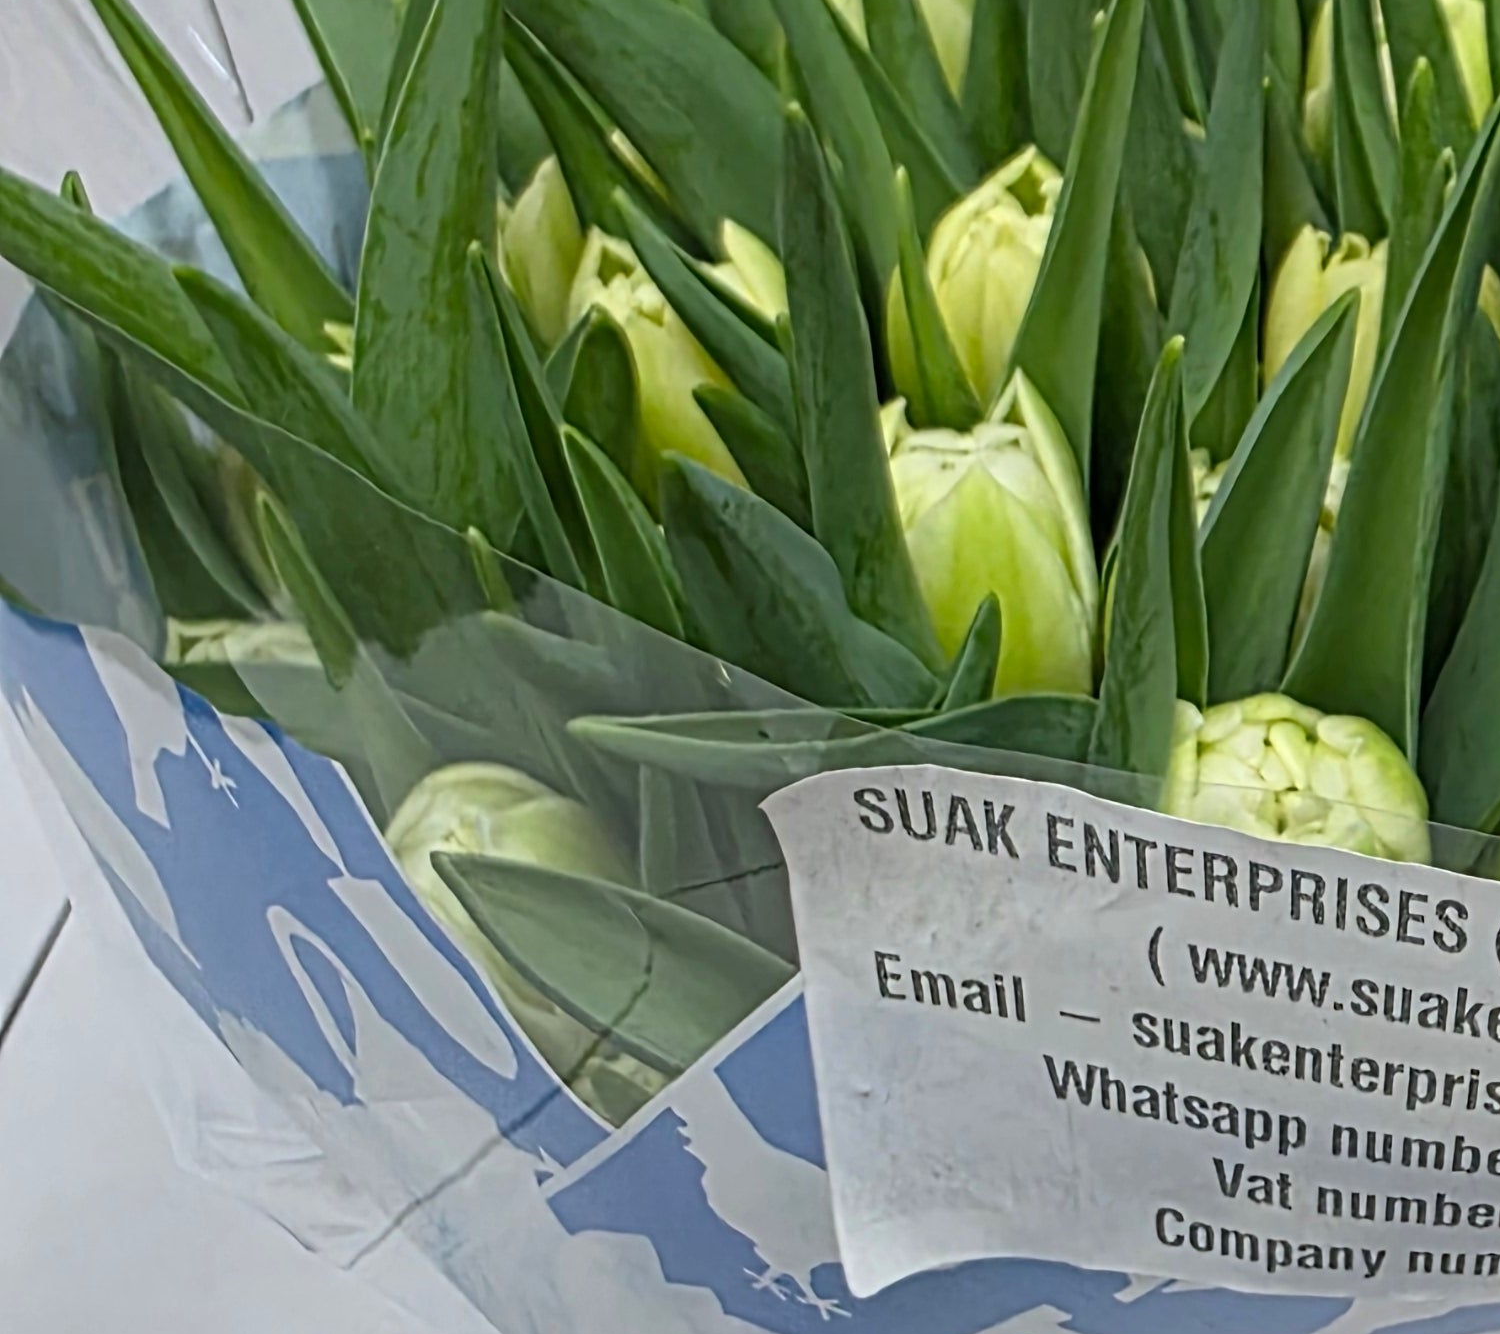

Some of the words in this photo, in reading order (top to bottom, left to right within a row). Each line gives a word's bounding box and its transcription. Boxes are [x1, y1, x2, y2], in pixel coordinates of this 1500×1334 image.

[853, 786, 1020, 860] SUAK
[1046, 812, 1469, 954] ENTERPRISES
[873, 950, 1026, 1023] Email
[1042, 1053, 1307, 1157] Whatsapp
[1212, 1157, 1293, 1212] Vat
[1155, 1207, 1387, 1279] Company
